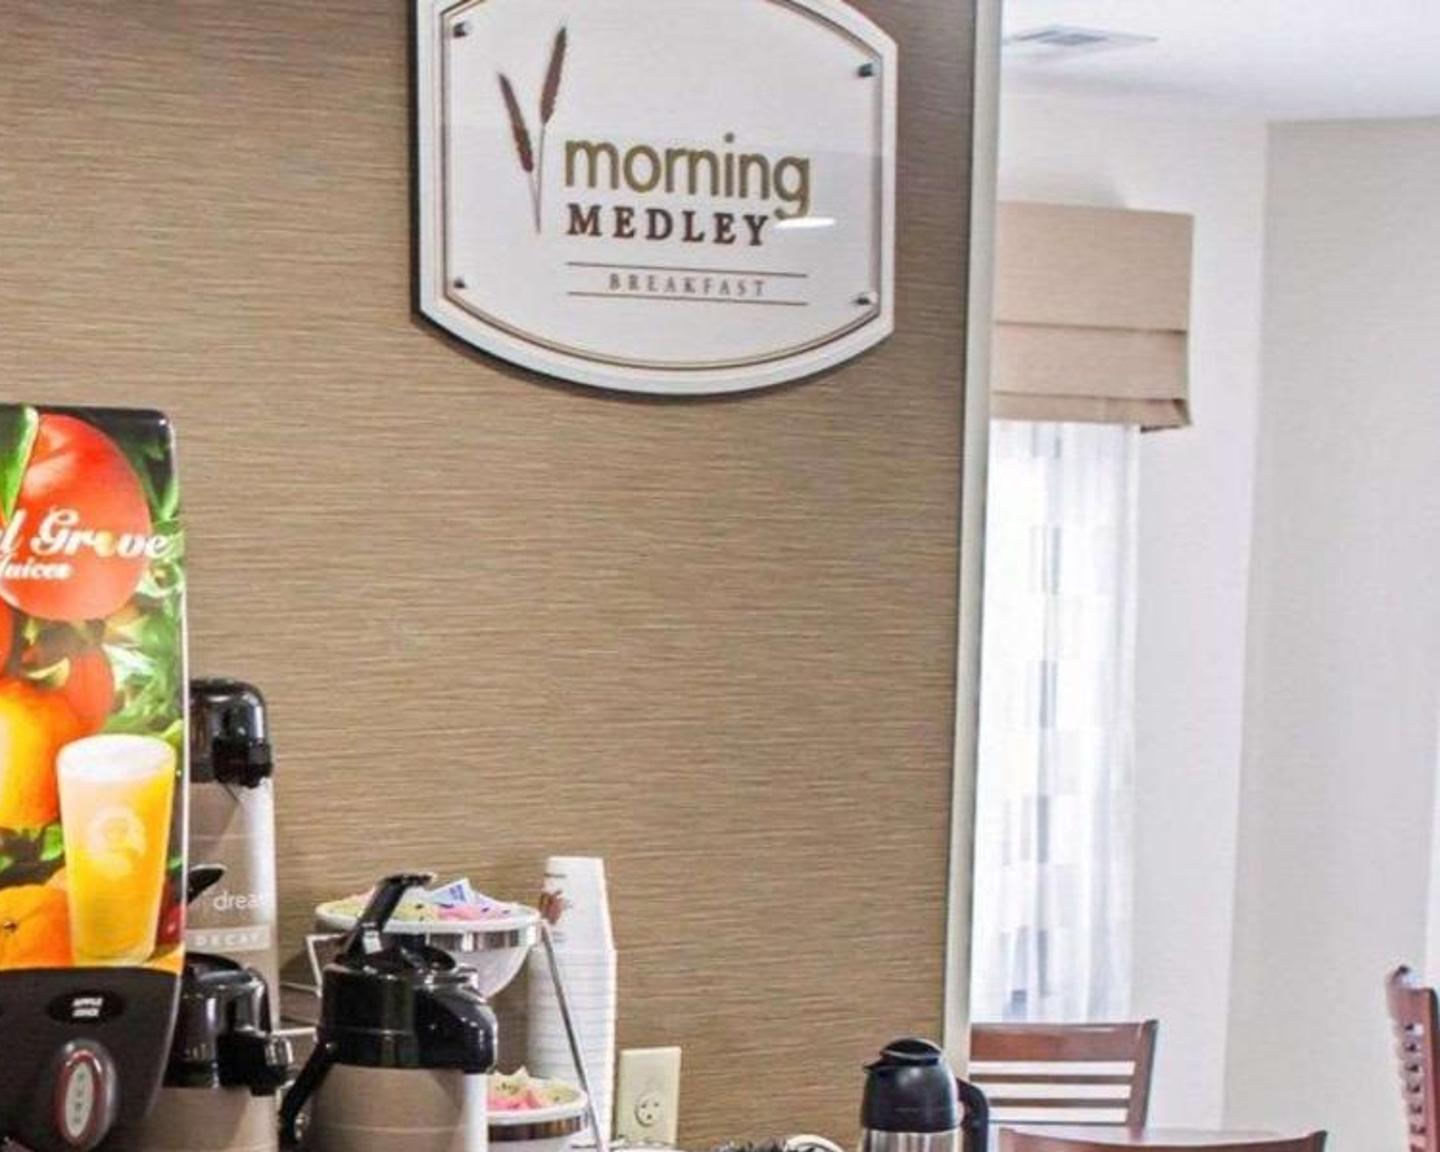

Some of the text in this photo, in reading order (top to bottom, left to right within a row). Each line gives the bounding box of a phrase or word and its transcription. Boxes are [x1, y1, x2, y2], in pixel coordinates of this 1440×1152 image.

[563, 131, 811, 222] morning
[567, 203, 769, 247] MEDLEY
[608, 272, 767, 297] BREAKFAST
